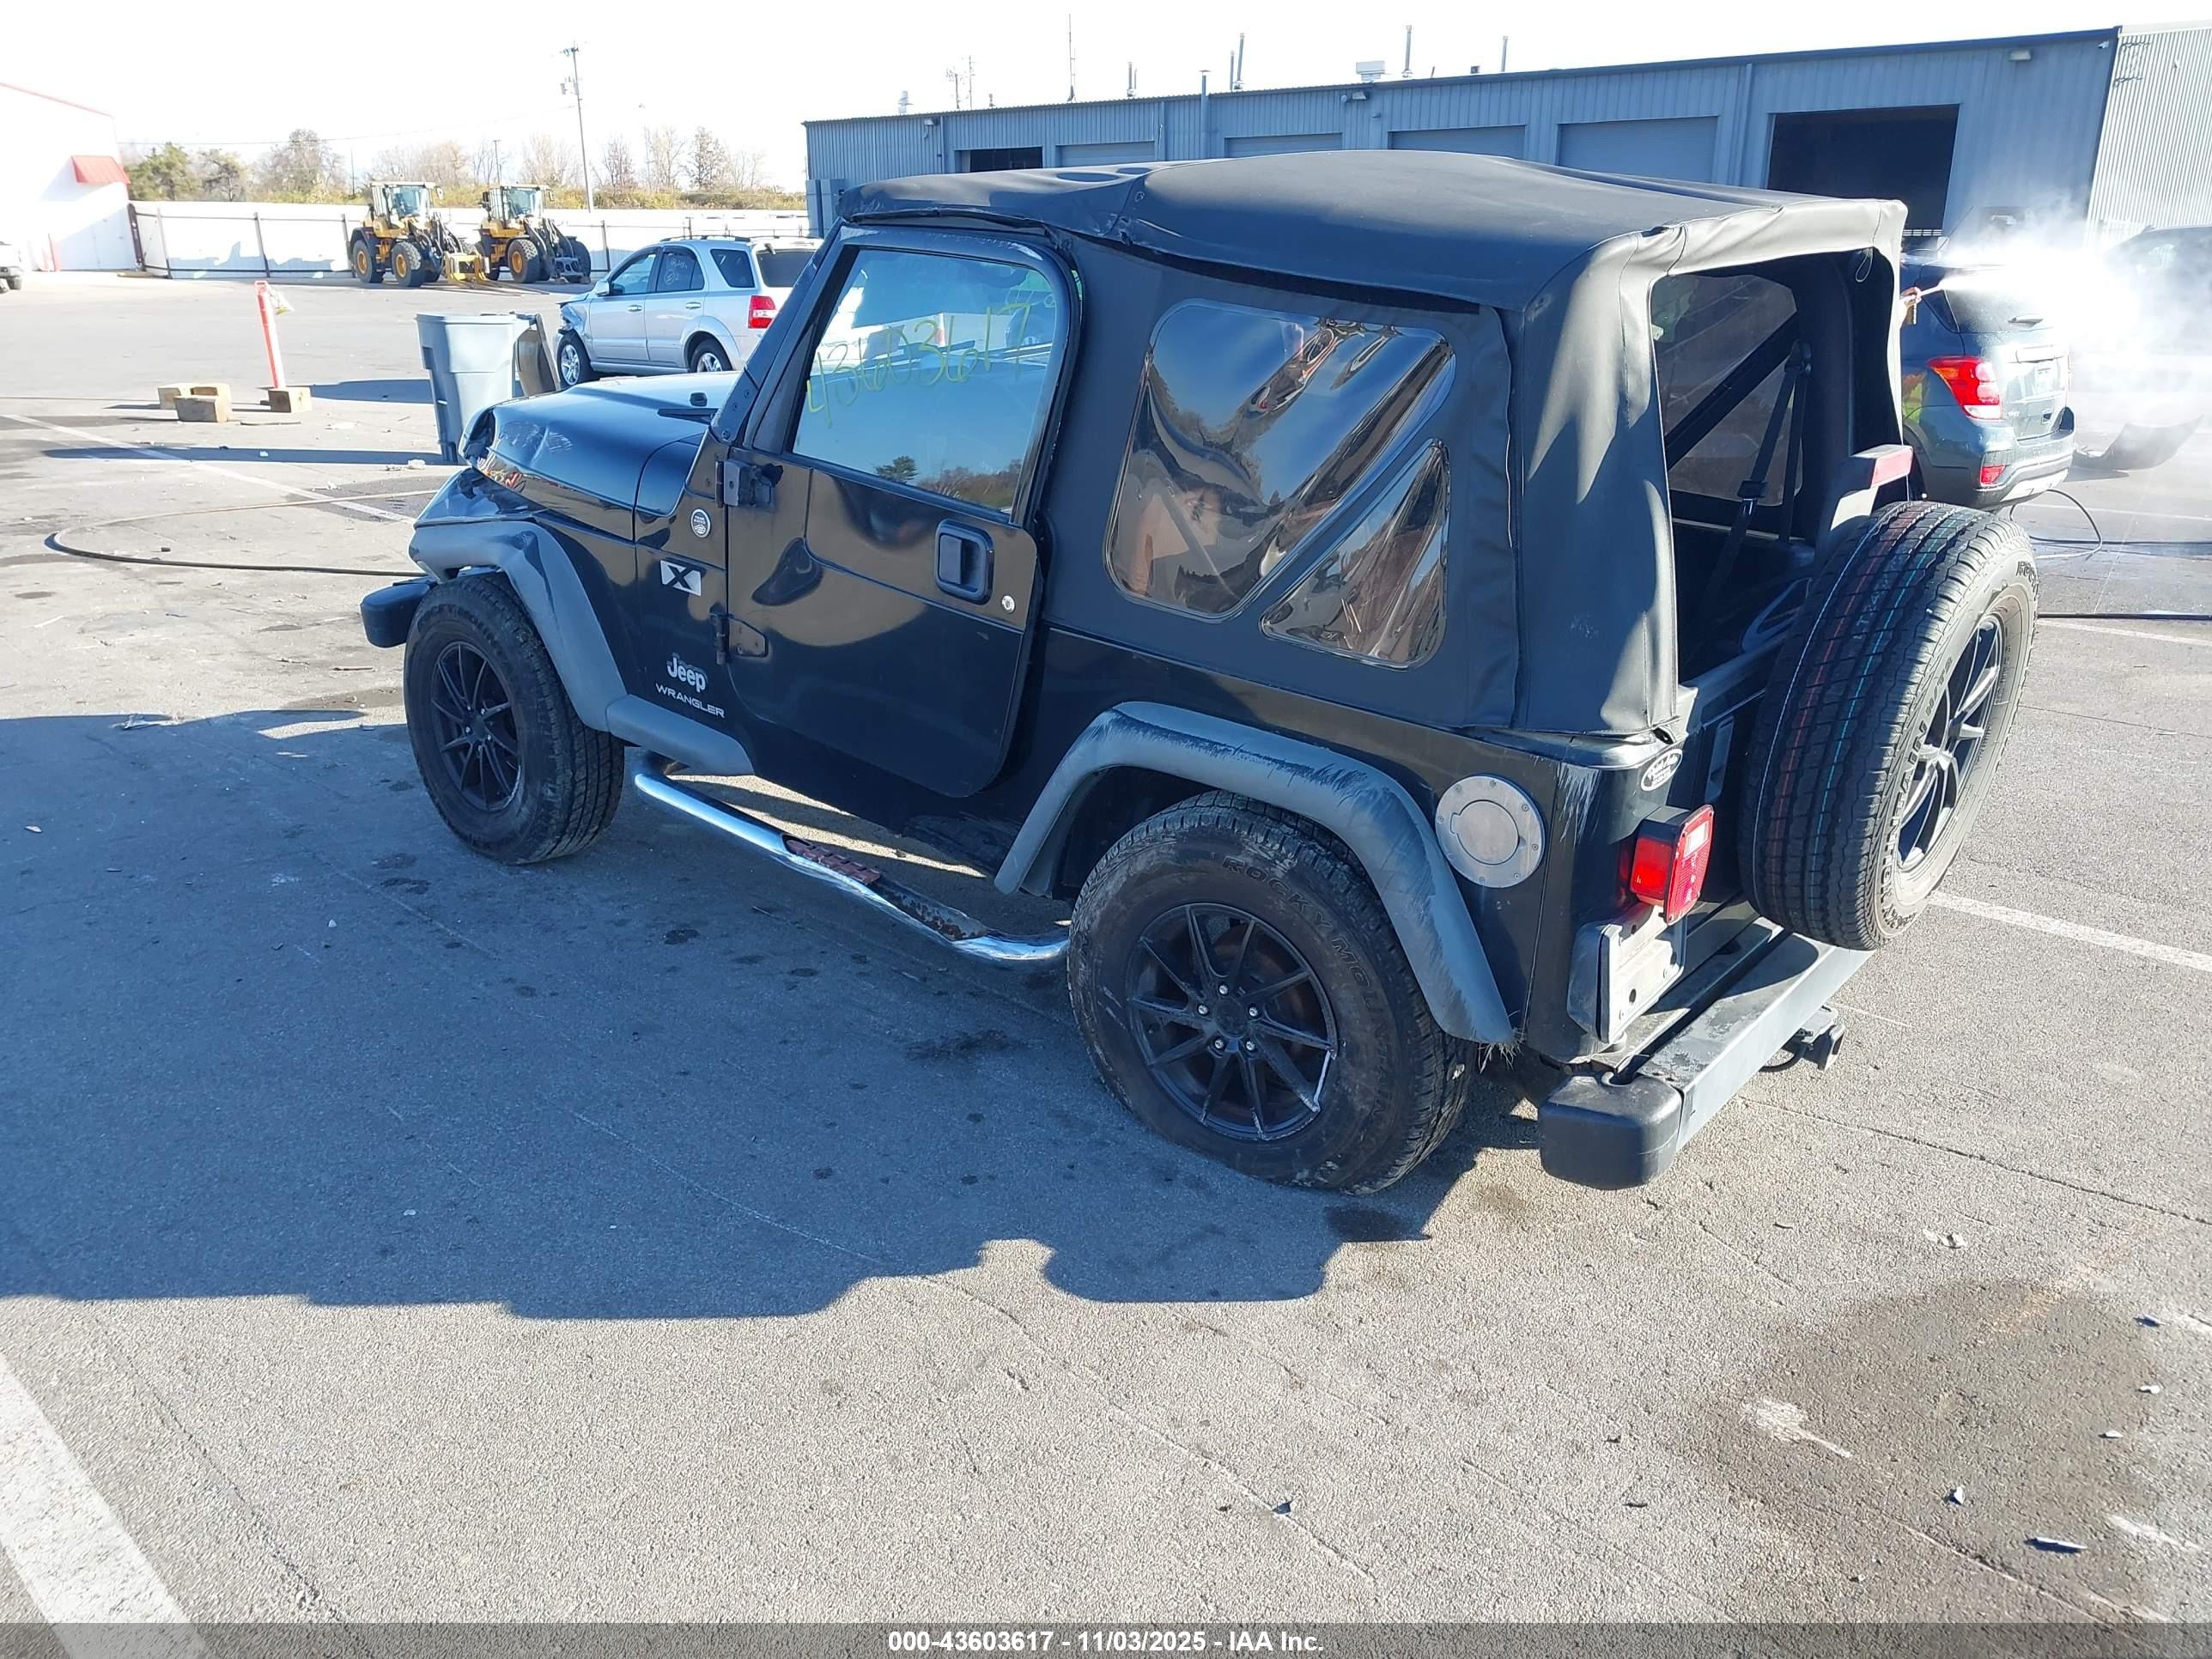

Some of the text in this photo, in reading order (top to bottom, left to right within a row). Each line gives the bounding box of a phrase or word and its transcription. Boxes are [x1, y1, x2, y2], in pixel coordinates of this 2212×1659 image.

[805, 302, 1031, 428] 43603617
[661, 562, 698, 593] X
[666, 656, 707, 693] Jeep
[655, 683, 725, 719] WRANGLER
[1222, 855, 1334, 929] ROCKY
